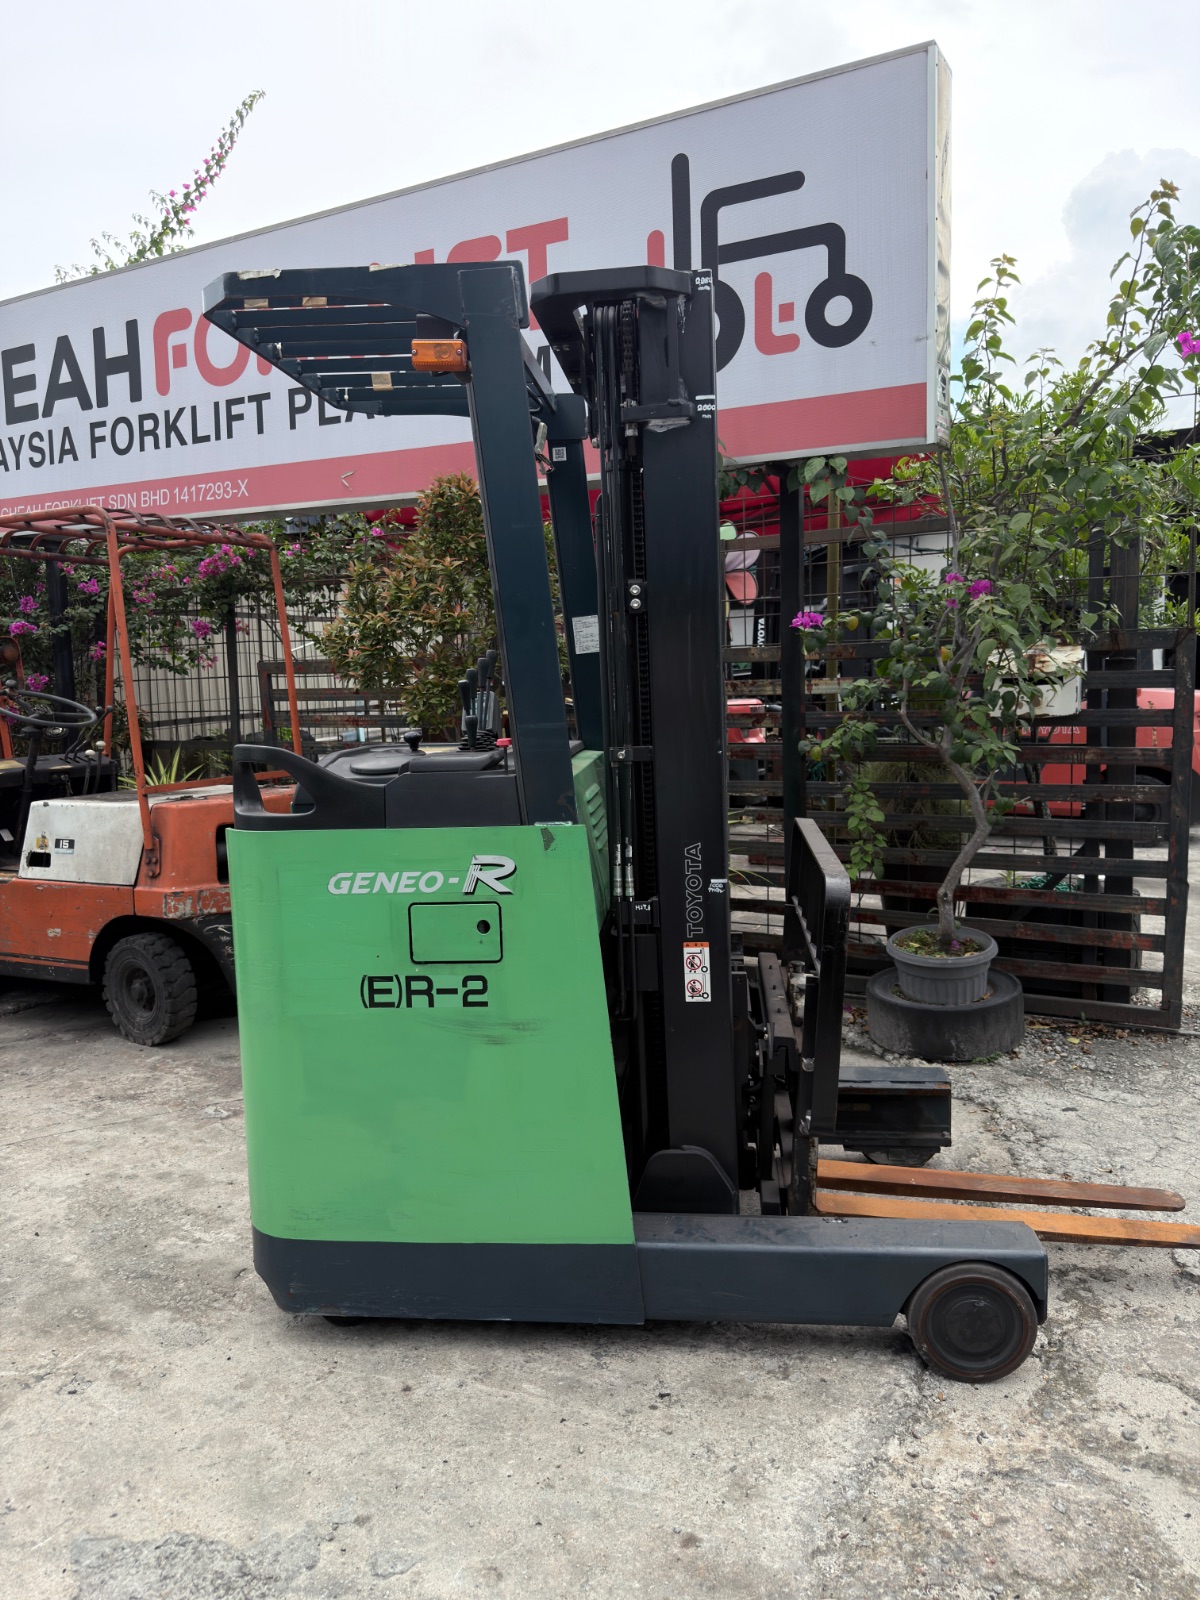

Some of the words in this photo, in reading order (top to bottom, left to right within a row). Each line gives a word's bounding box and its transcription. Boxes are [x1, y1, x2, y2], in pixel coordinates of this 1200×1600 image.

[90, 392, 271, 459] FORKLIFT
[109, 492, 137, 510] SDN
[141, 488, 170, 508] BHD
[174, 479, 249, 504] 1417293-X
[757, 617, 765, 647] YOTA
[60, 839, 70, 849] 15
[327, 854, 517, 895] GENEO-R
[684, 842, 704, 938] TOYOTA
[360, 974, 489, 1009] (E)R-2
